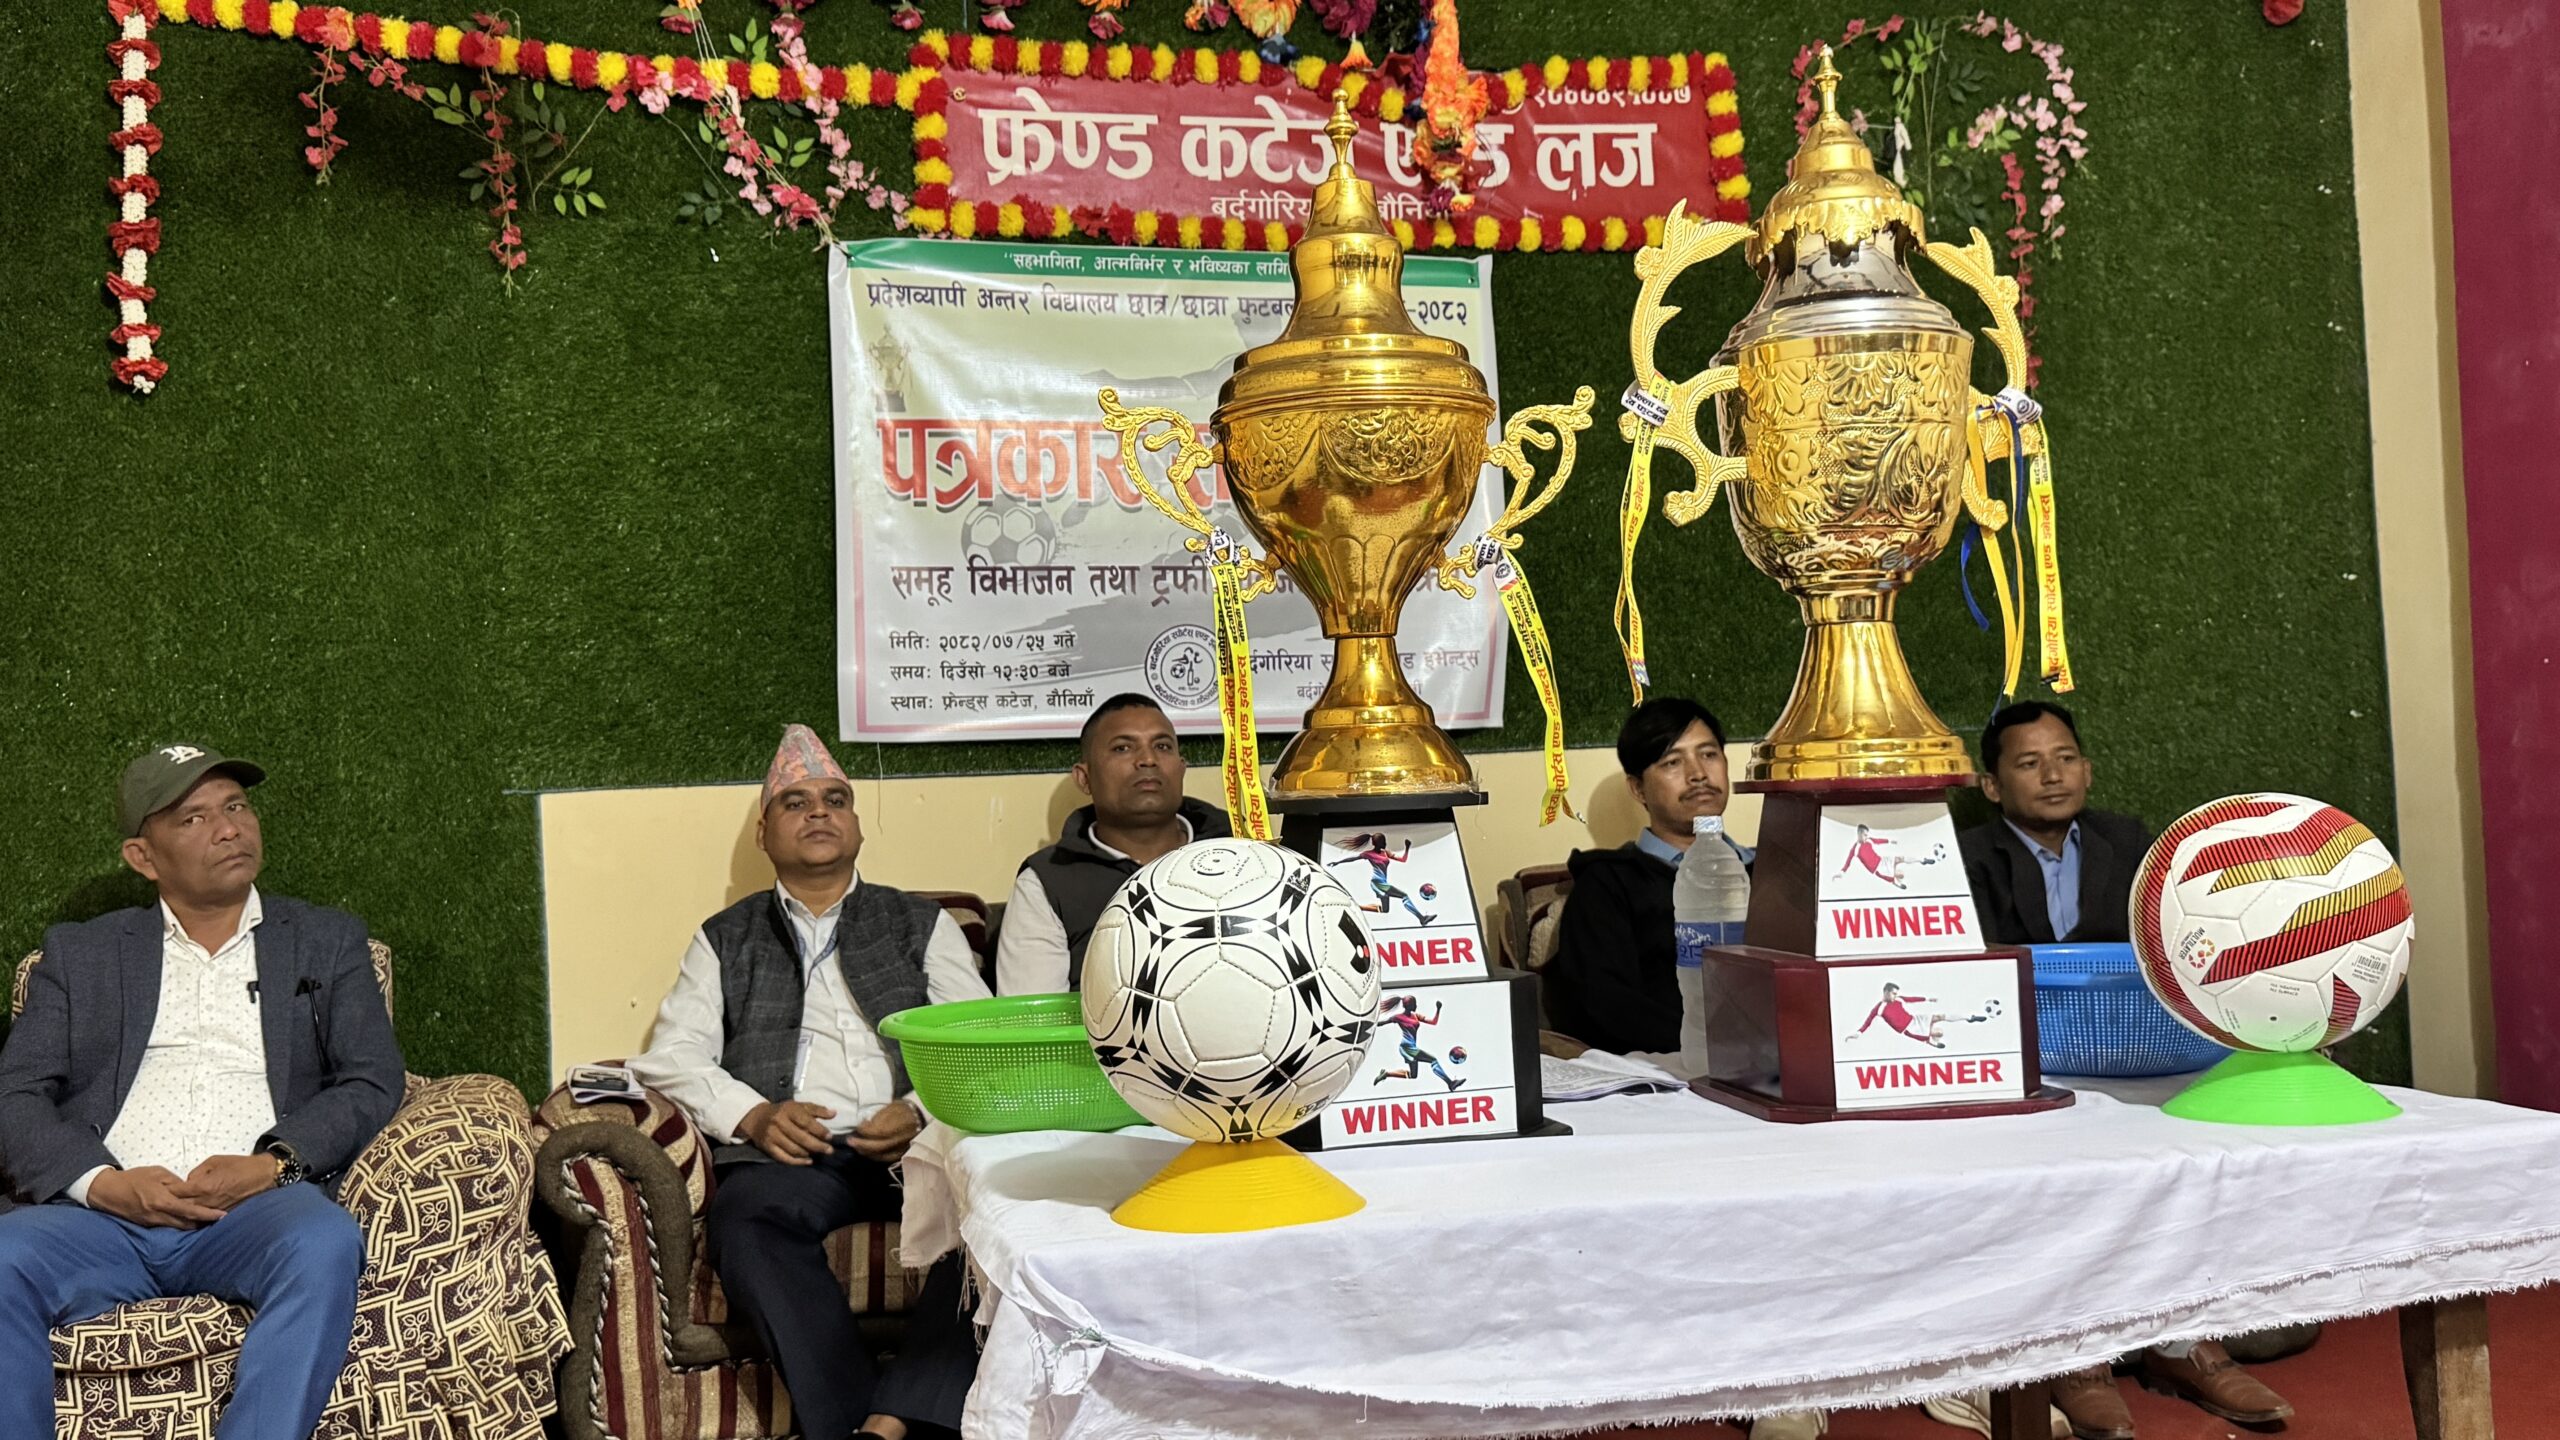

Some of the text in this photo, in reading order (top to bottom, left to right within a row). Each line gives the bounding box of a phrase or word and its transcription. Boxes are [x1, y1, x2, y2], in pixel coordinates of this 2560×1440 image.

[977, 87, 1159, 187] फ्रेण्ड
[1380, 122, 1514, 188] एड
[1210, 189, 1313, 220] बर्दगोरिय
[1094, 253, 1166, 274] आत्मनिर्भर
[1172, 259, 1184, 275] र
[1188, 254, 1250, 276] भविष्यका
[866, 278, 967, 308] प्रदेशव्यापी
[976, 287, 1032, 315] अन्तर
[1040, 282, 1119, 316] विद्यालय
[876, 418, 1148, 513] पत्रकार
[890, 565, 954, 606] समूह
[966, 554, 1076, 596] विभाजन
[1088, 565, 1140, 597] तथा
[1152, 556, 1207, 607] ट्रफी
[940, 634, 1045, 652] २०८२/०७/२५
[1053, 630, 1076, 649] गते
[993, 664, 1039, 682] १२:३०
[1832, 904, 1966, 940] WINNER
[1375, 936, 1476, 969] NNER
[1855, 1058, 2004, 1091] WINNER
[1341, 1094, 1497, 1136] WINNER
